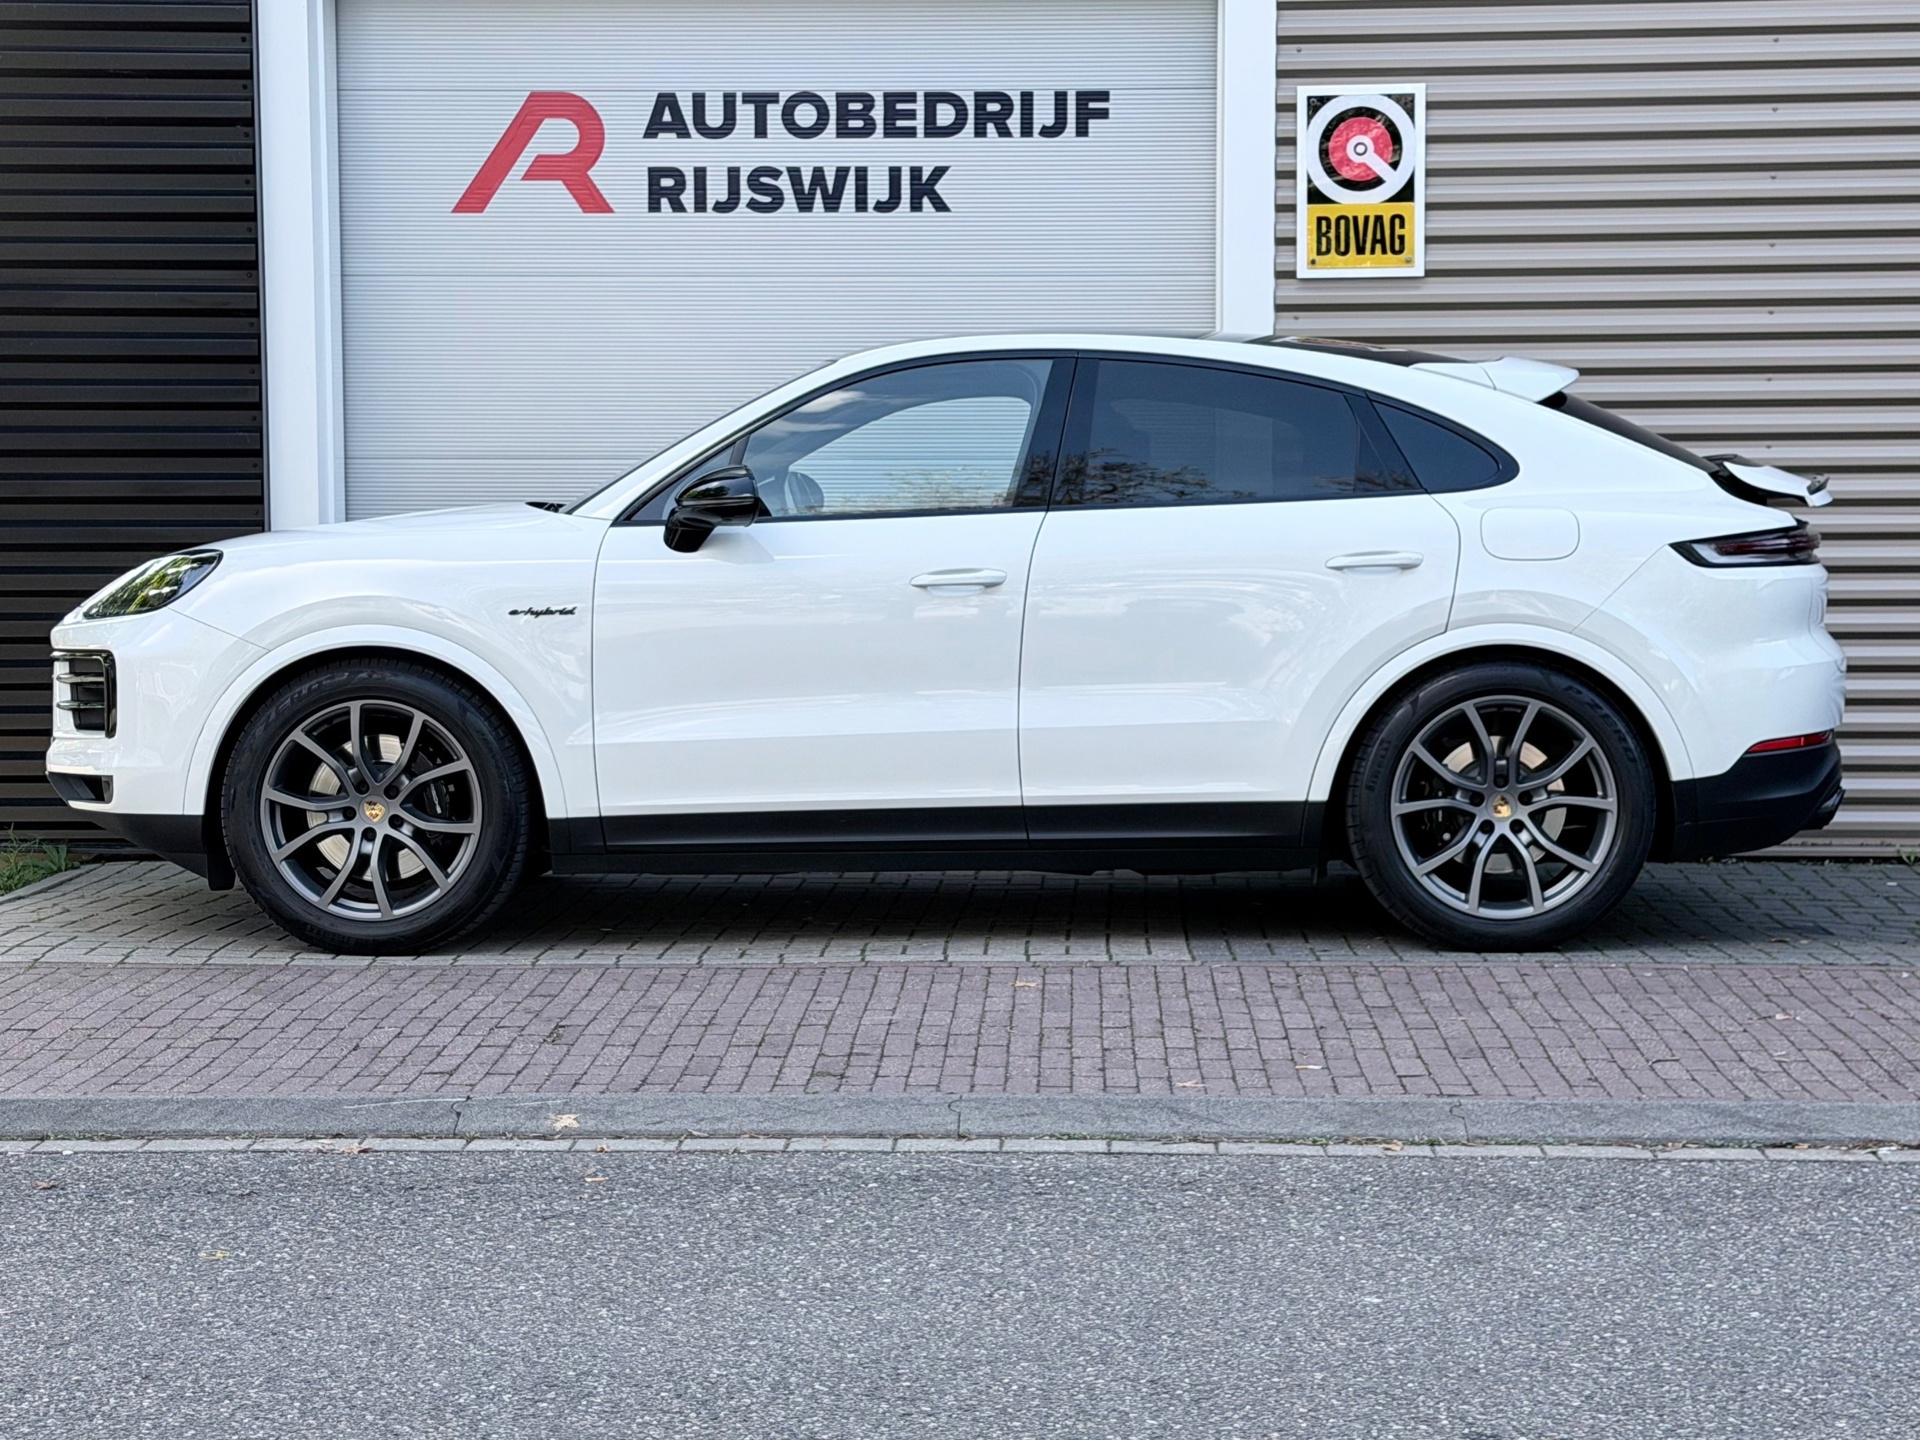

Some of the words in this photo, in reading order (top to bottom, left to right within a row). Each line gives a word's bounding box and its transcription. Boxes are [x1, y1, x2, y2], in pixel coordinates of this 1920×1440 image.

[642, 90, 1110, 139] AUTOBEDRIJF
[647, 165, 952, 214] RIJSWIJK
[1315, 213, 1406, 257] BOVAG
